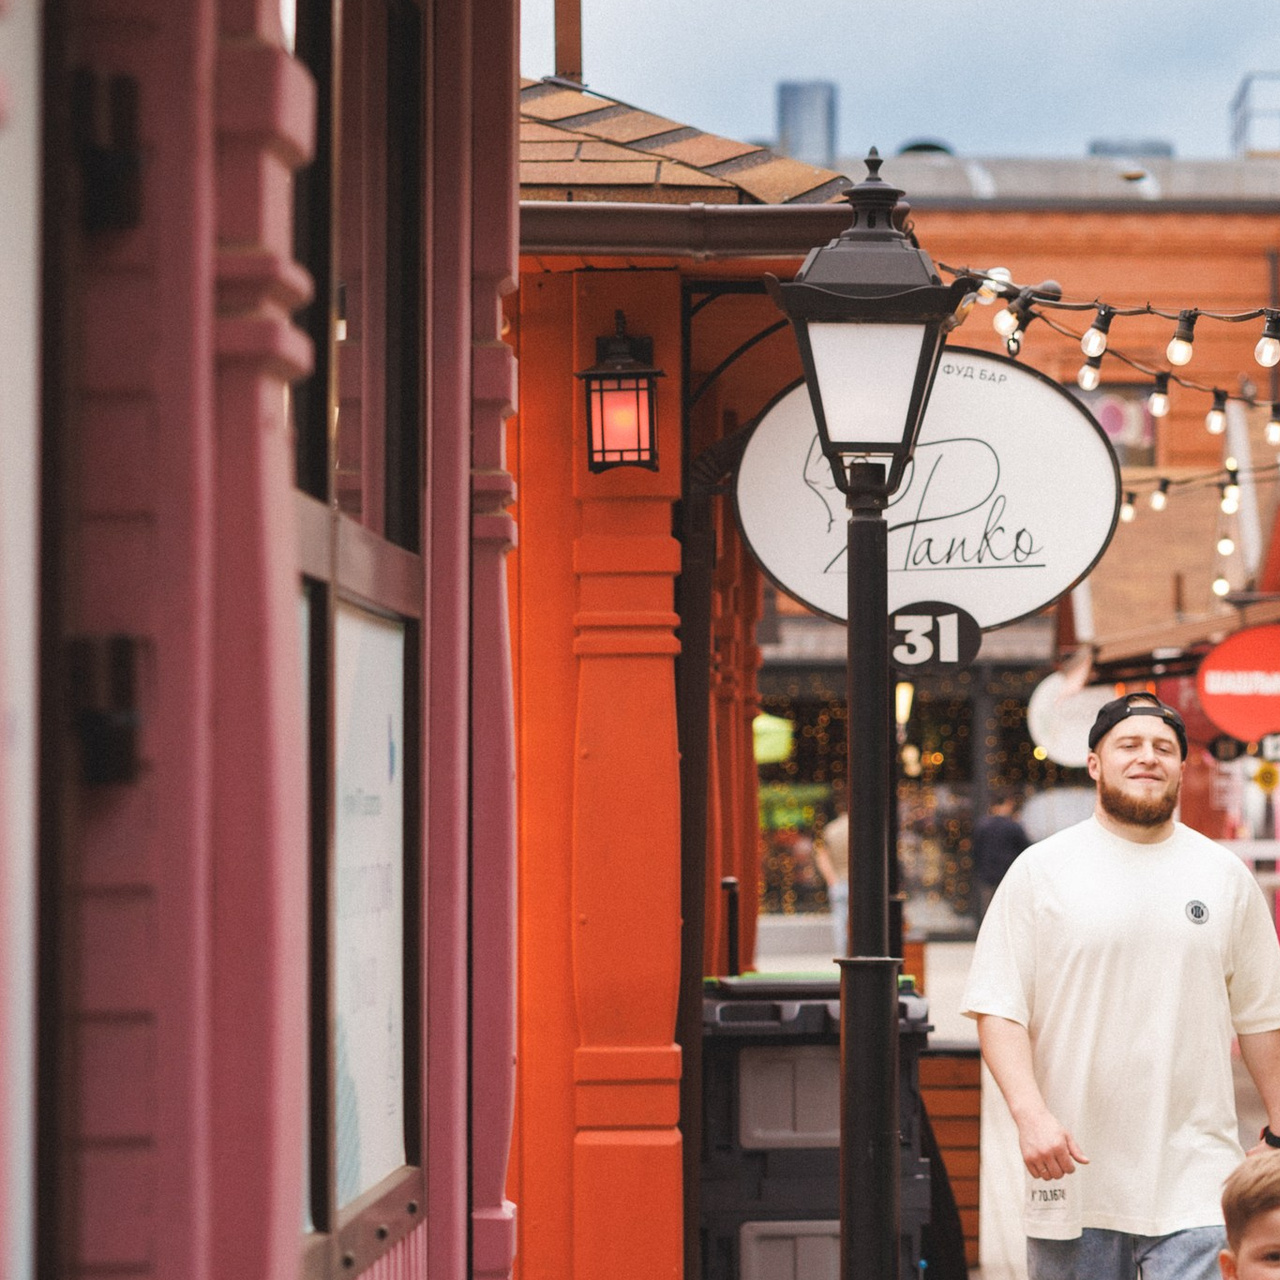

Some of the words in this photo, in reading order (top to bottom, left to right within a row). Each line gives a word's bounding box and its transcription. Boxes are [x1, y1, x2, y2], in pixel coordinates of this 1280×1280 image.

[942, 362, 974, 380] ФУД
[979, 369, 1008, 385] БАР
[893, 612, 960, 666] 31
